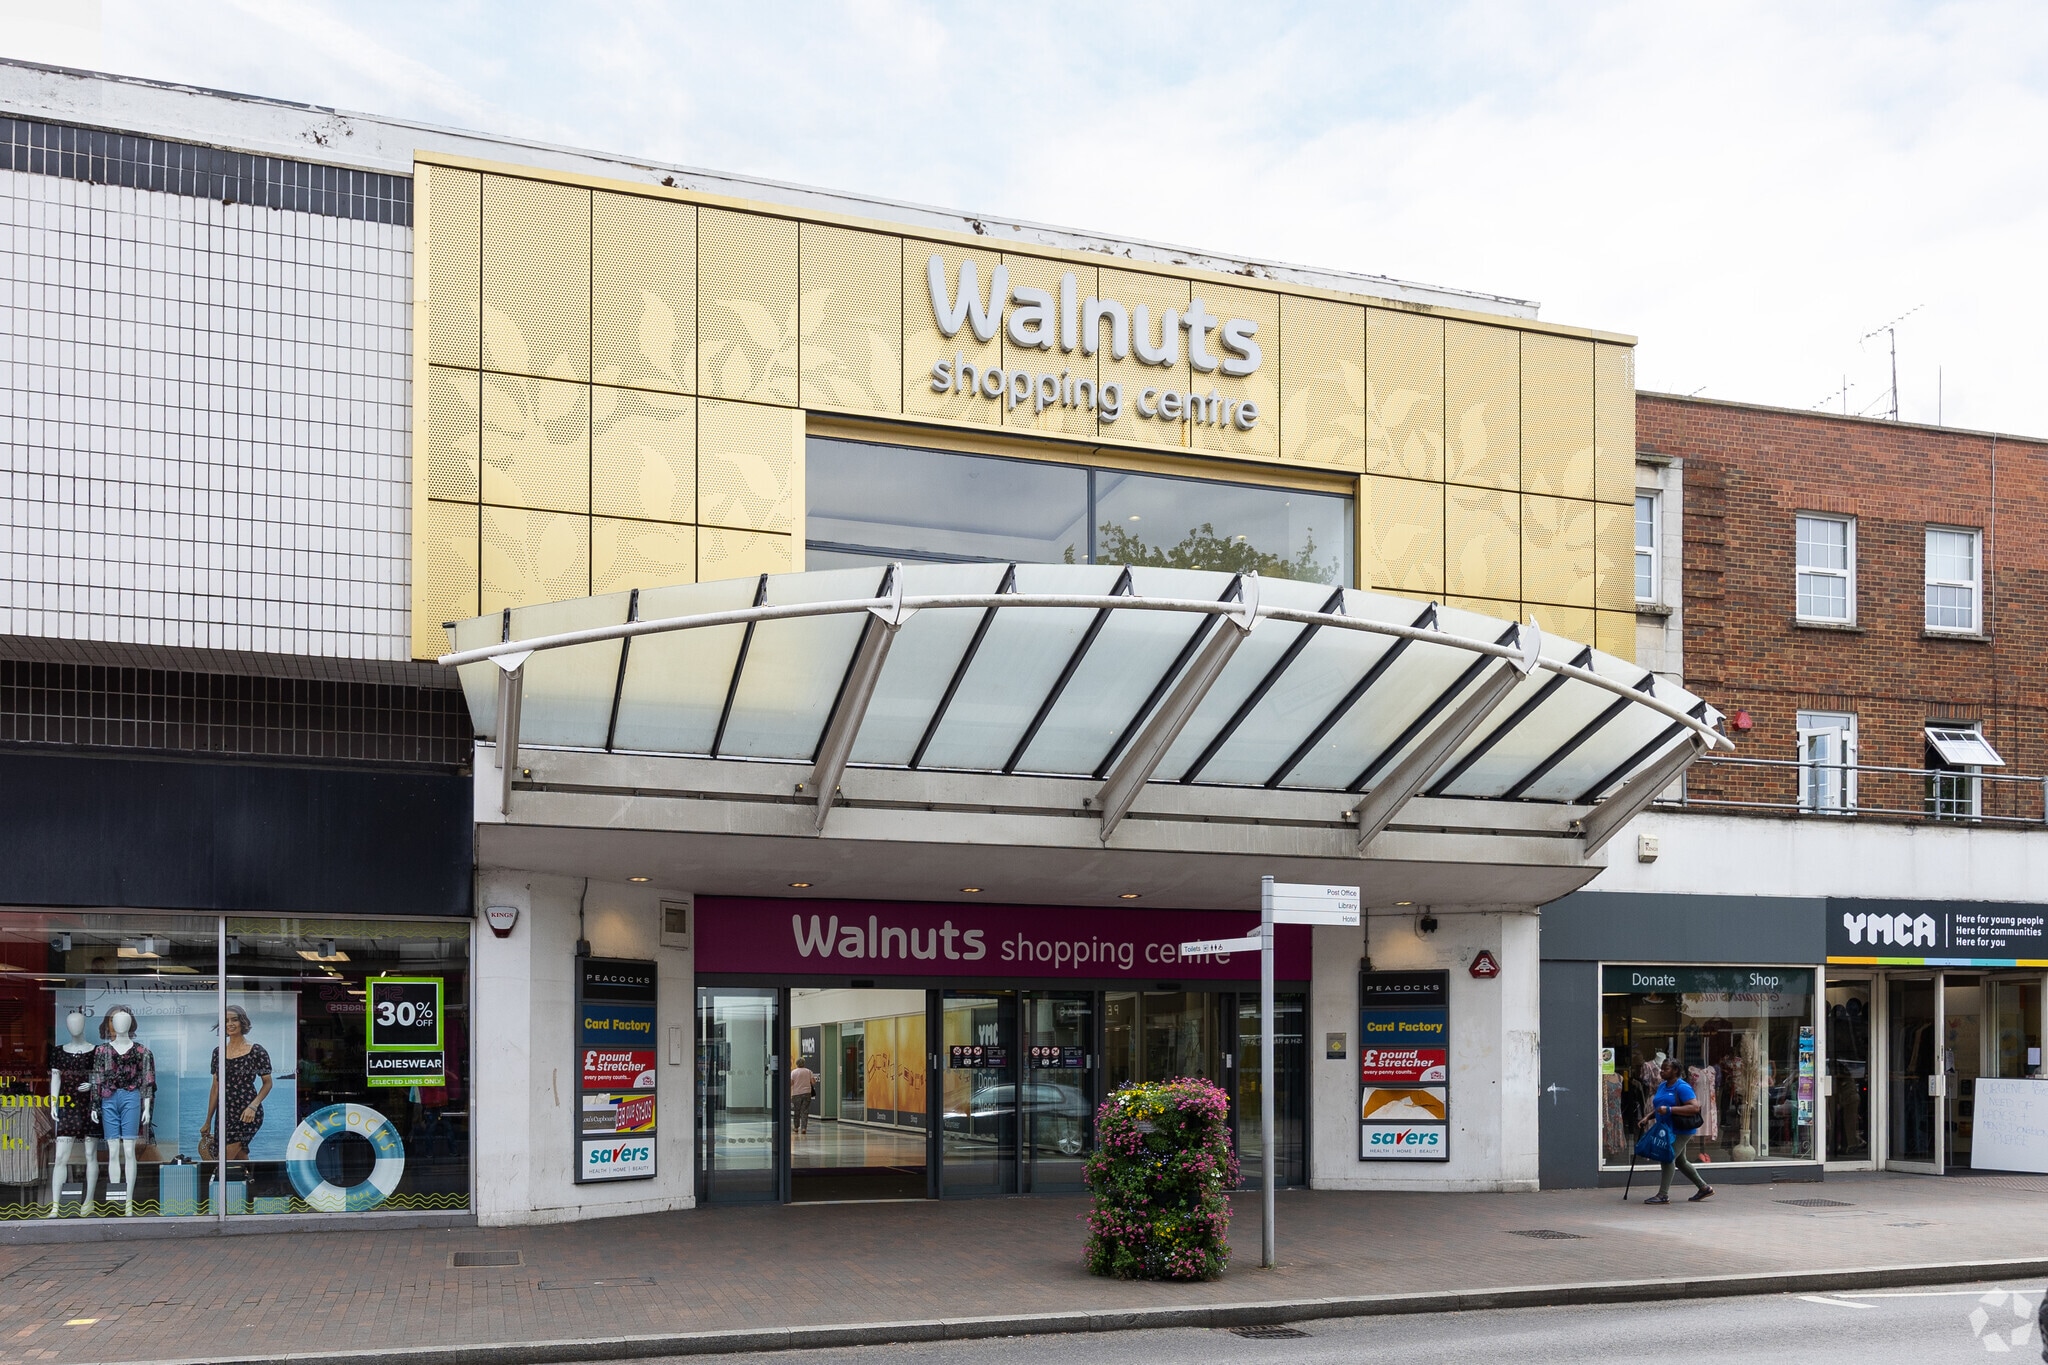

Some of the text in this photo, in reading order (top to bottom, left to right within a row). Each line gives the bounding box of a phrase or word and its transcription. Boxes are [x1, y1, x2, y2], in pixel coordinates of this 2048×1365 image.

[927, 254, 1262, 376] Walnuts
[932, 350, 1259, 431] shopping centre
[1341, 889, 1357, 897] Office
[1338, 902, 1357, 910] Library
[1956, 914, 2044, 926] Here for young people
[1843, 912, 1936, 947] YMCA
[1956, 926, 2042, 937] Here for communities
[792, 914, 987, 960] Walnuts
[1001, 932, 1133, 970] shopping
[1956, 937, 2006, 948] Here for you
[1184, 945, 1200, 953] Toilets
[586, 974, 650, 984] PEACOCKS
[1632, 973, 1779, 988] Donate Shop
[376, 1001, 433, 1026] 30%
[585, 1018, 650, 1033] Card Factory
[1367, 1022, 1443, 1033] Card Factory
[599, 1052, 632, 1063] pound
[1380, 1050, 1418, 1060] pound
[369, 1059, 442, 1069] LADIESWEAR
[597, 1060, 645, 1072] stretcher
[1378, 1059, 1434, 1067] stretcher
[296, 1111, 396, 1152] PEACOCKS
[1370, 1129, 1439, 1145] savers
[589, 1143, 649, 1164] savers
